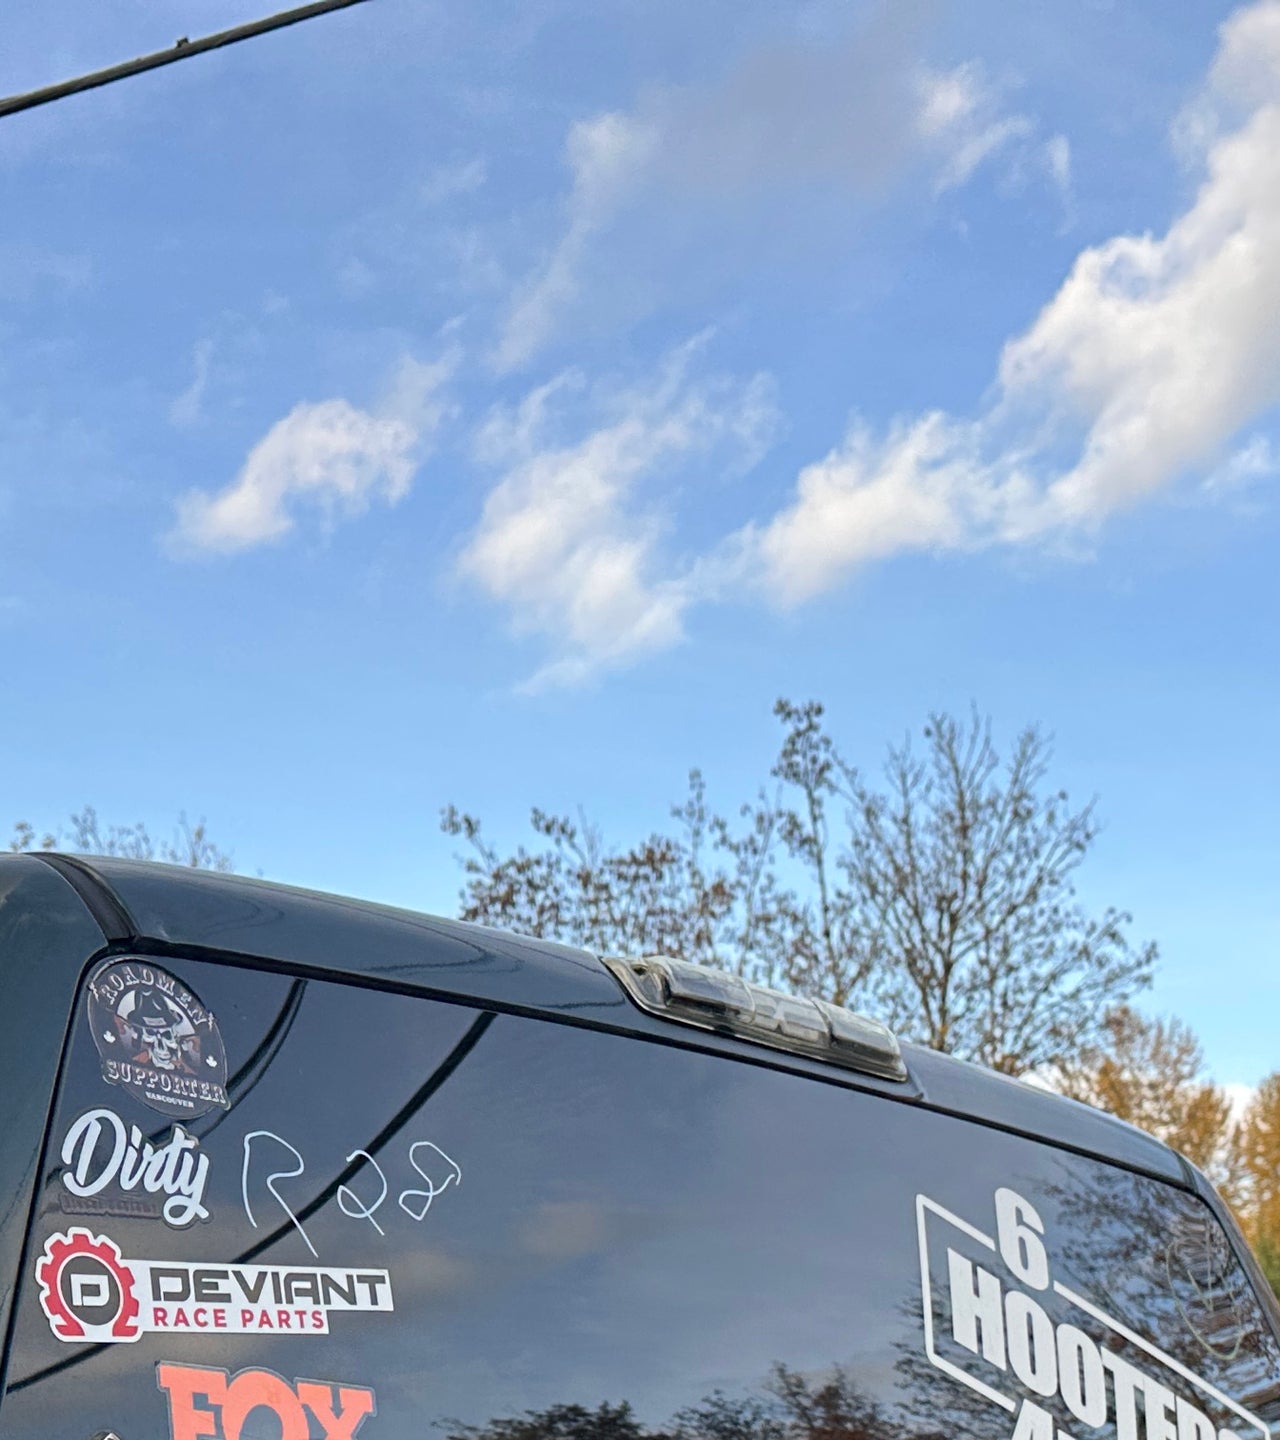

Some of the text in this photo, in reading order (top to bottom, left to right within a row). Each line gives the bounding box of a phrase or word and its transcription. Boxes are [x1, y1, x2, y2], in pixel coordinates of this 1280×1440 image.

[105, 1059, 227, 1105] SUPPORTER
[145, 1091, 195, 1108] VANCOUVER
[61, 1108, 210, 1226] Dirty
[994, 1187, 1050, 1291] 6
[149, 1267, 387, 1306] DEVIANT
[152, 1306, 325, 1330] RACE PARTS
